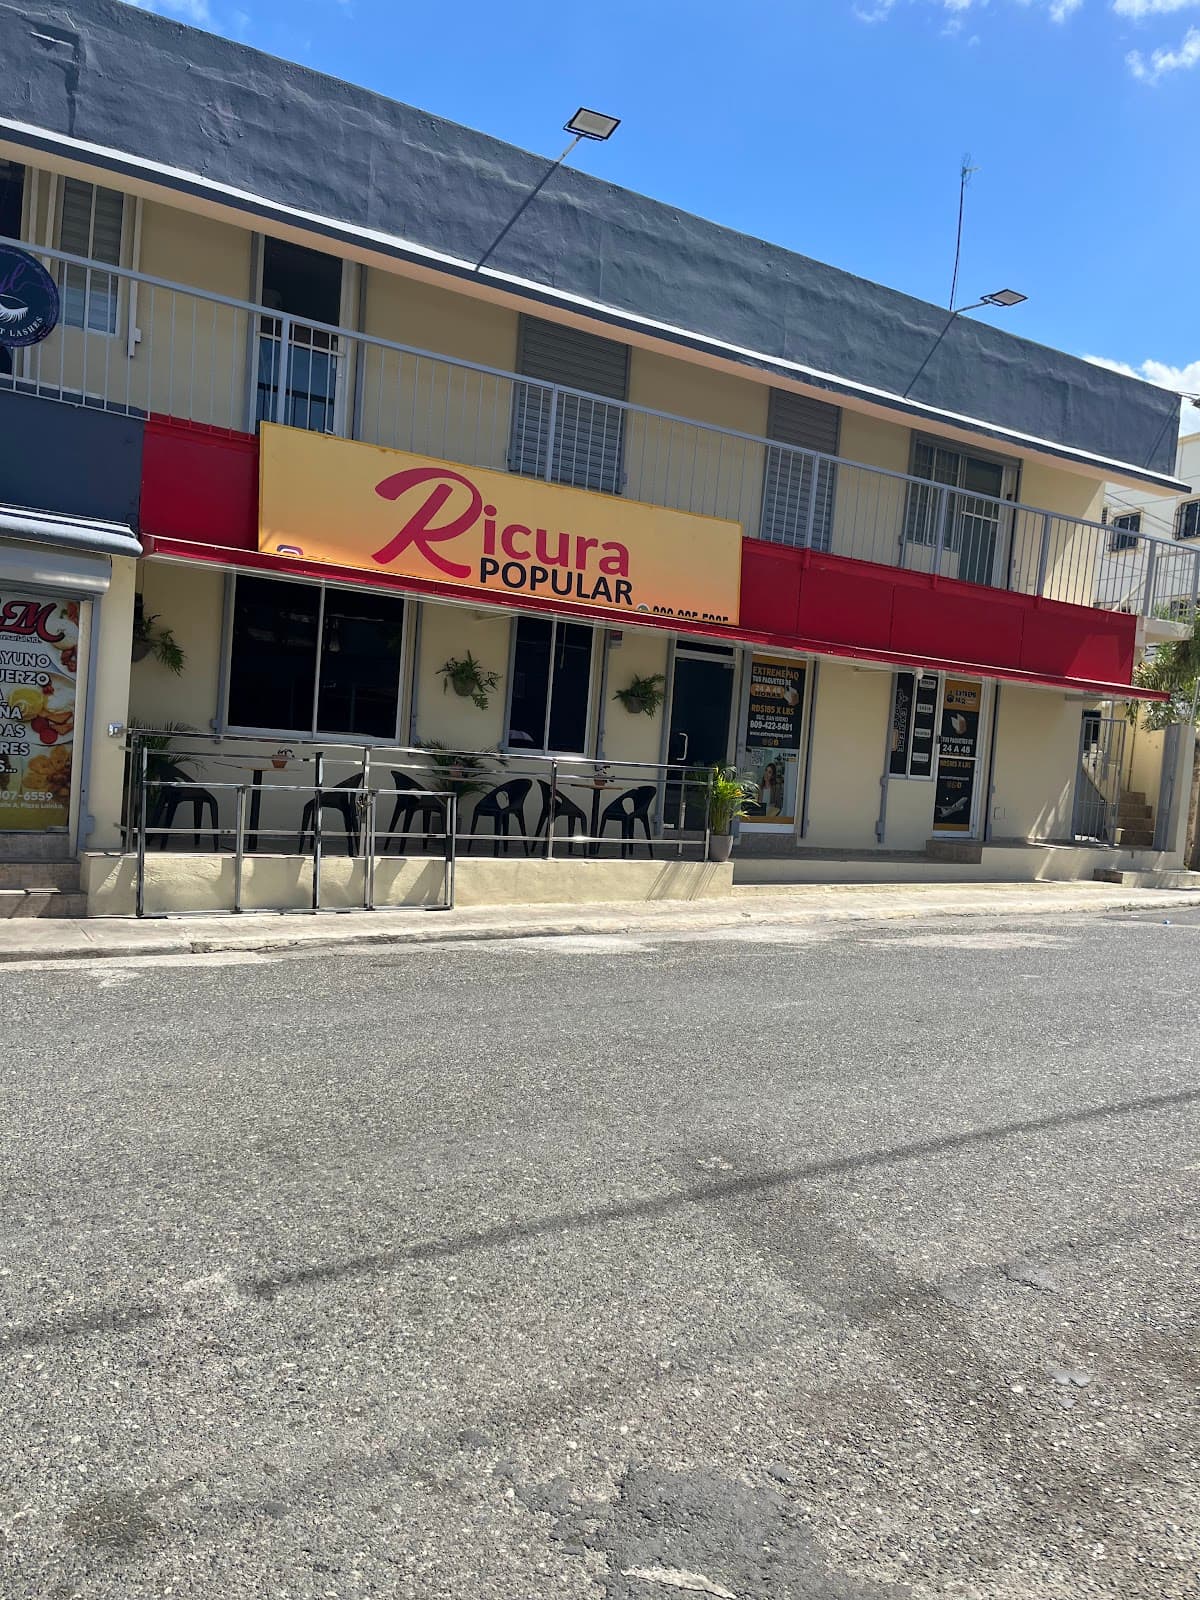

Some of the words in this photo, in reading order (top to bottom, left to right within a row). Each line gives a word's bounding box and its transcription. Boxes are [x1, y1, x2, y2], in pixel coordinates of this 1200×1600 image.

[10, 315, 43, 337] LASHES
[371, 467, 629, 578] Ricura
[480, 556, 633, 606] POPULAR
[0, 724, 25, 738] AS
[942, 744, 952, 752] 24
[0, 791, 53, 801] 07-6559
